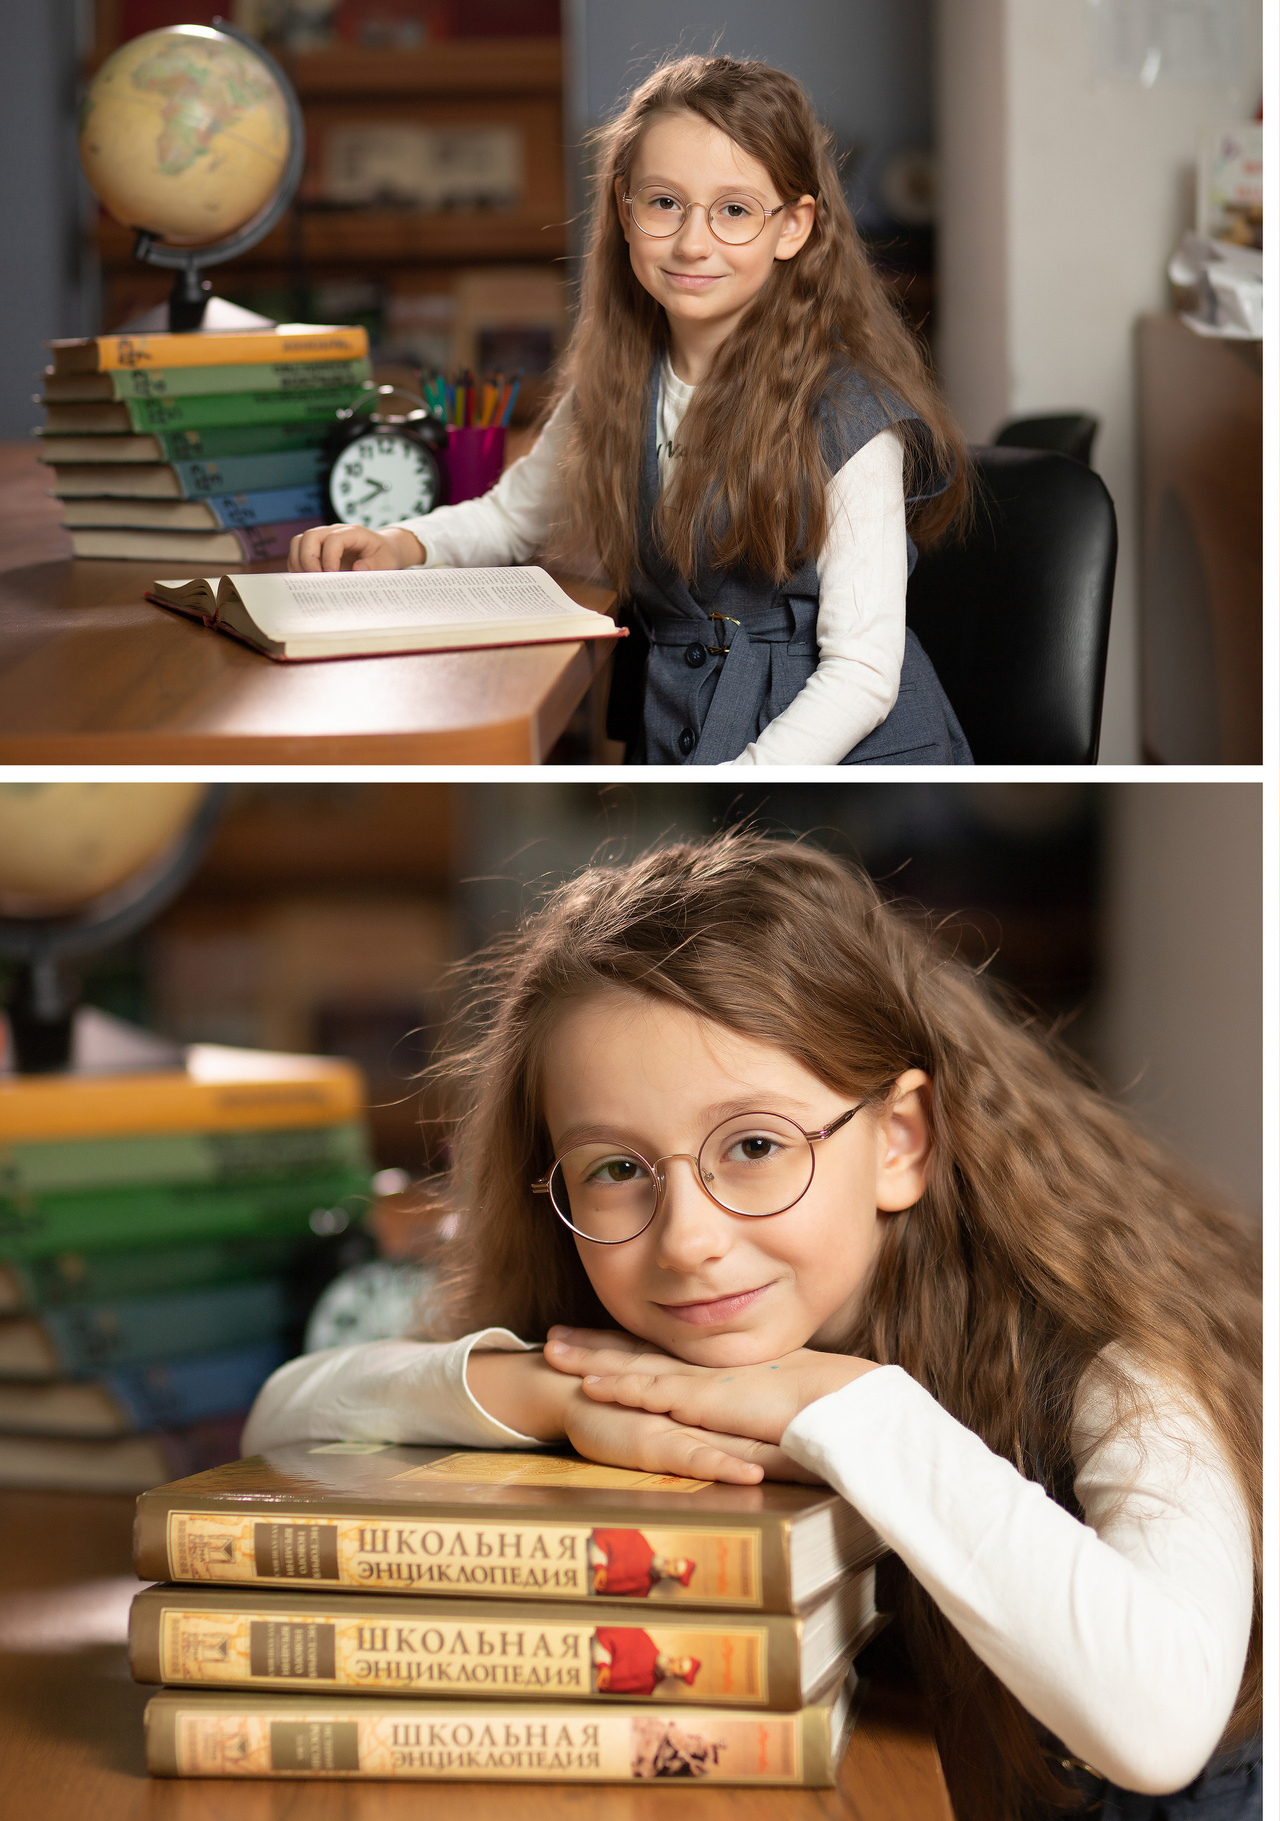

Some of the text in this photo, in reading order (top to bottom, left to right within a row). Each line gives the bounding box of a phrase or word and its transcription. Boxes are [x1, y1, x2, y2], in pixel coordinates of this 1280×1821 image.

[358, 1528, 578, 1560] ШКОЛЬНАЯ
[357, 1561, 579, 1589] ЭНЦИКЛОПЕДИЯ
[356, 1627, 581, 1657] ШКОЛЬНАЯ
[355, 1660, 581, 1687] ЭНЦИКЛОПЕДИЯ
[391, 1723, 600, 1747] ШКОЛЬНАЯ
[392, 1751, 600, 1770] ЭНЦИКЛОПЕДИЯ
